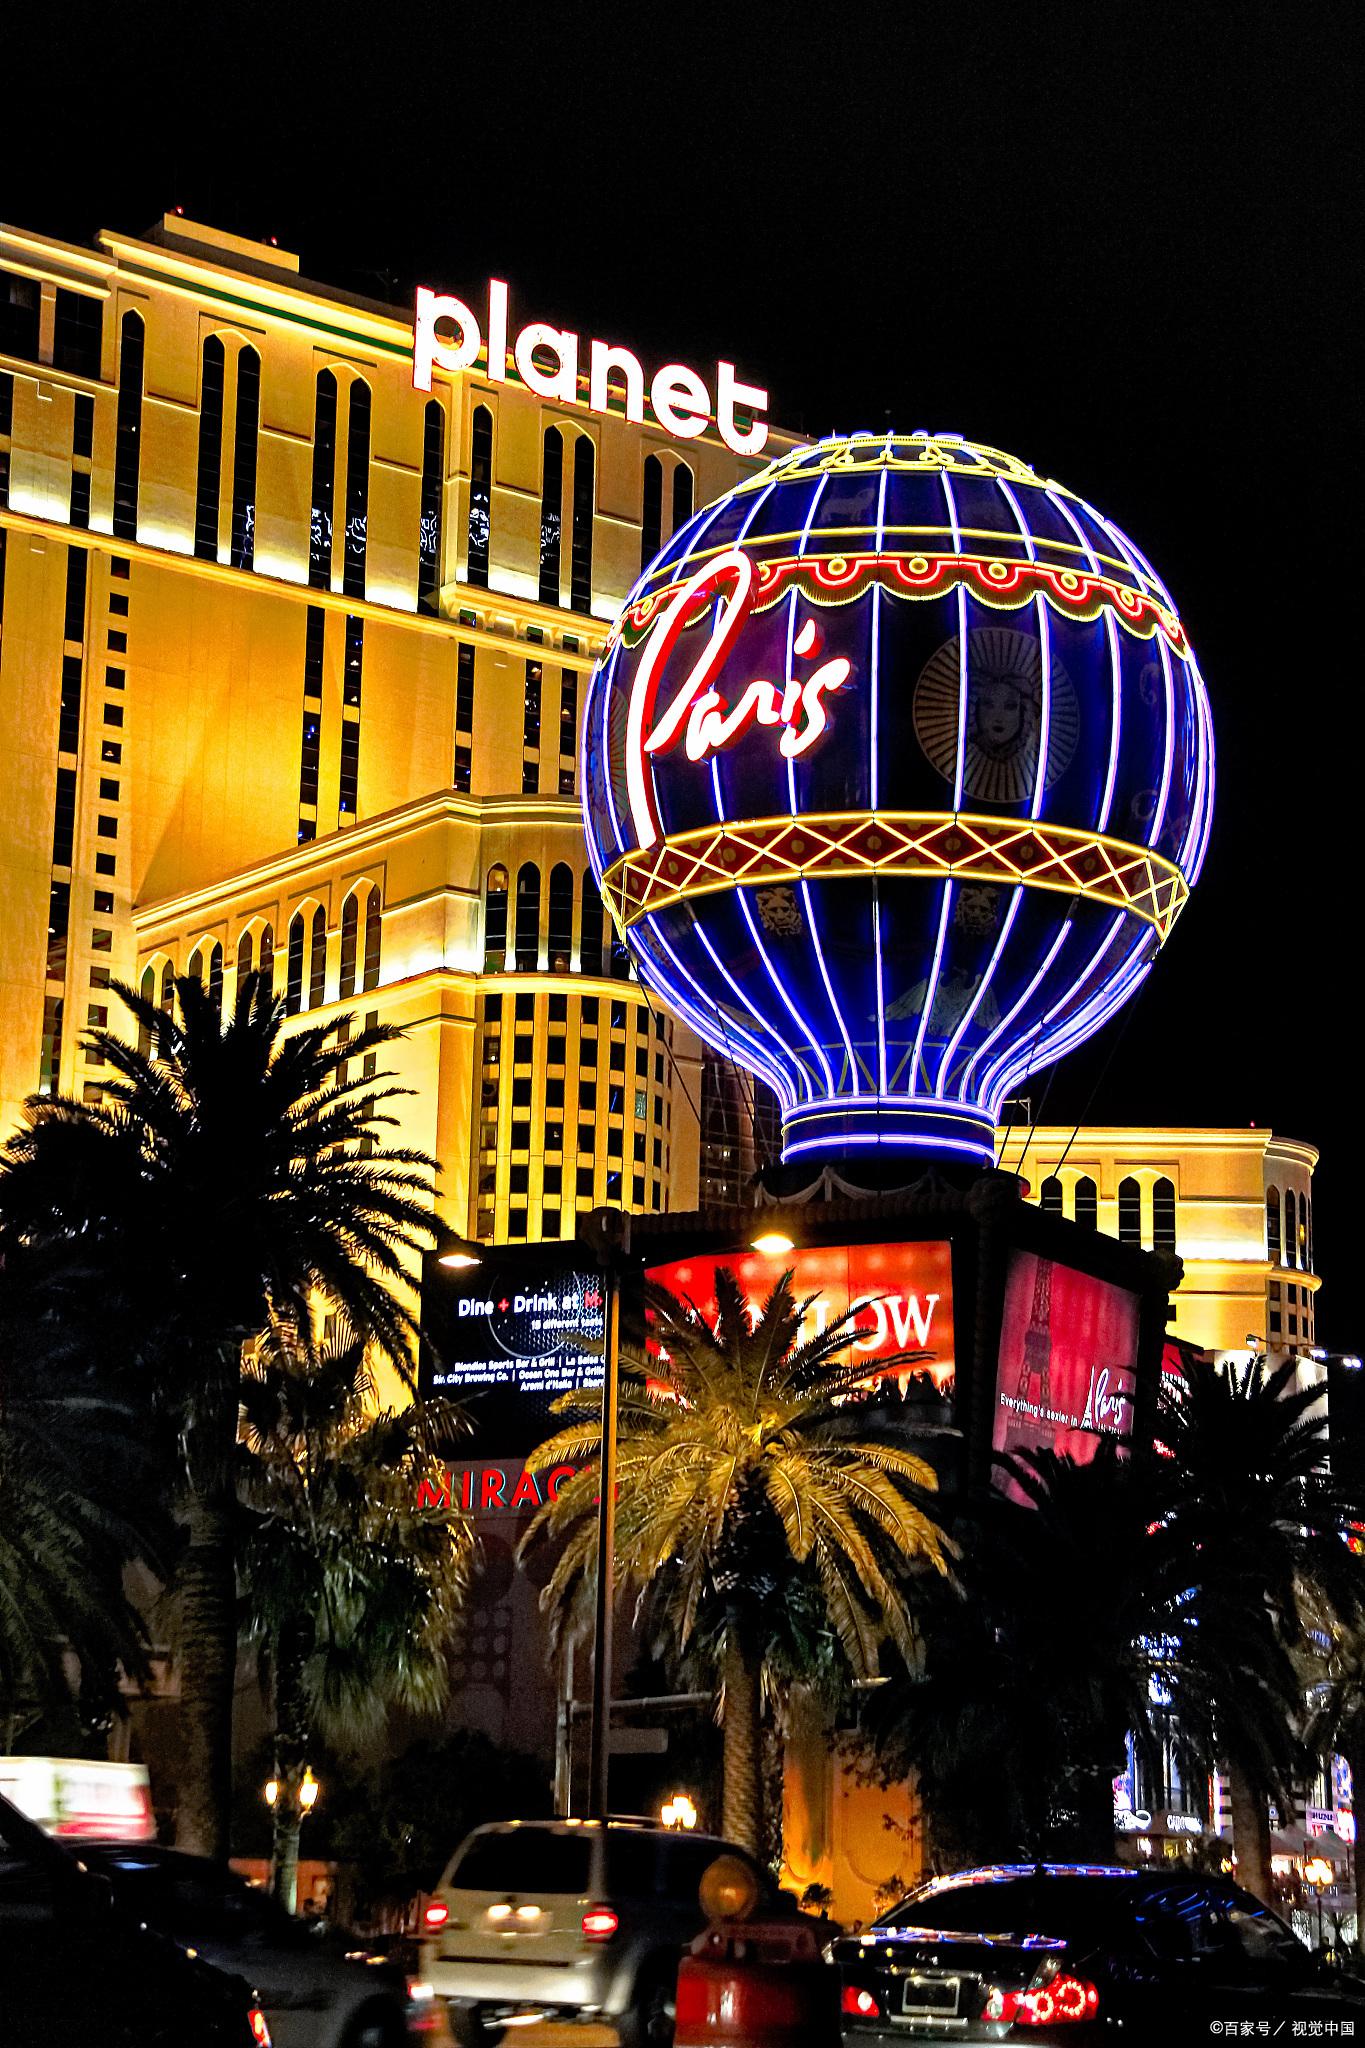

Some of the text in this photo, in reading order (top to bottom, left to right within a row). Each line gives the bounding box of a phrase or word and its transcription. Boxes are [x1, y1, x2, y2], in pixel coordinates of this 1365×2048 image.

[412, 277, 769, 456] planet
[625, 549, 851, 850] Paris
[458, 1298, 495, 1317] Dine
[513, 1292, 558, 1313] Drink
[561, 1294, 579, 1310] at
[446, 1372, 463, 1386] City
[464, 1371, 496, 1384] Brewing
[1094, 1367, 1126, 1425] Paris
[1000, 1392, 1078, 1427] Everything's sexier in
[417, 1465, 600, 1509] MIRAC
